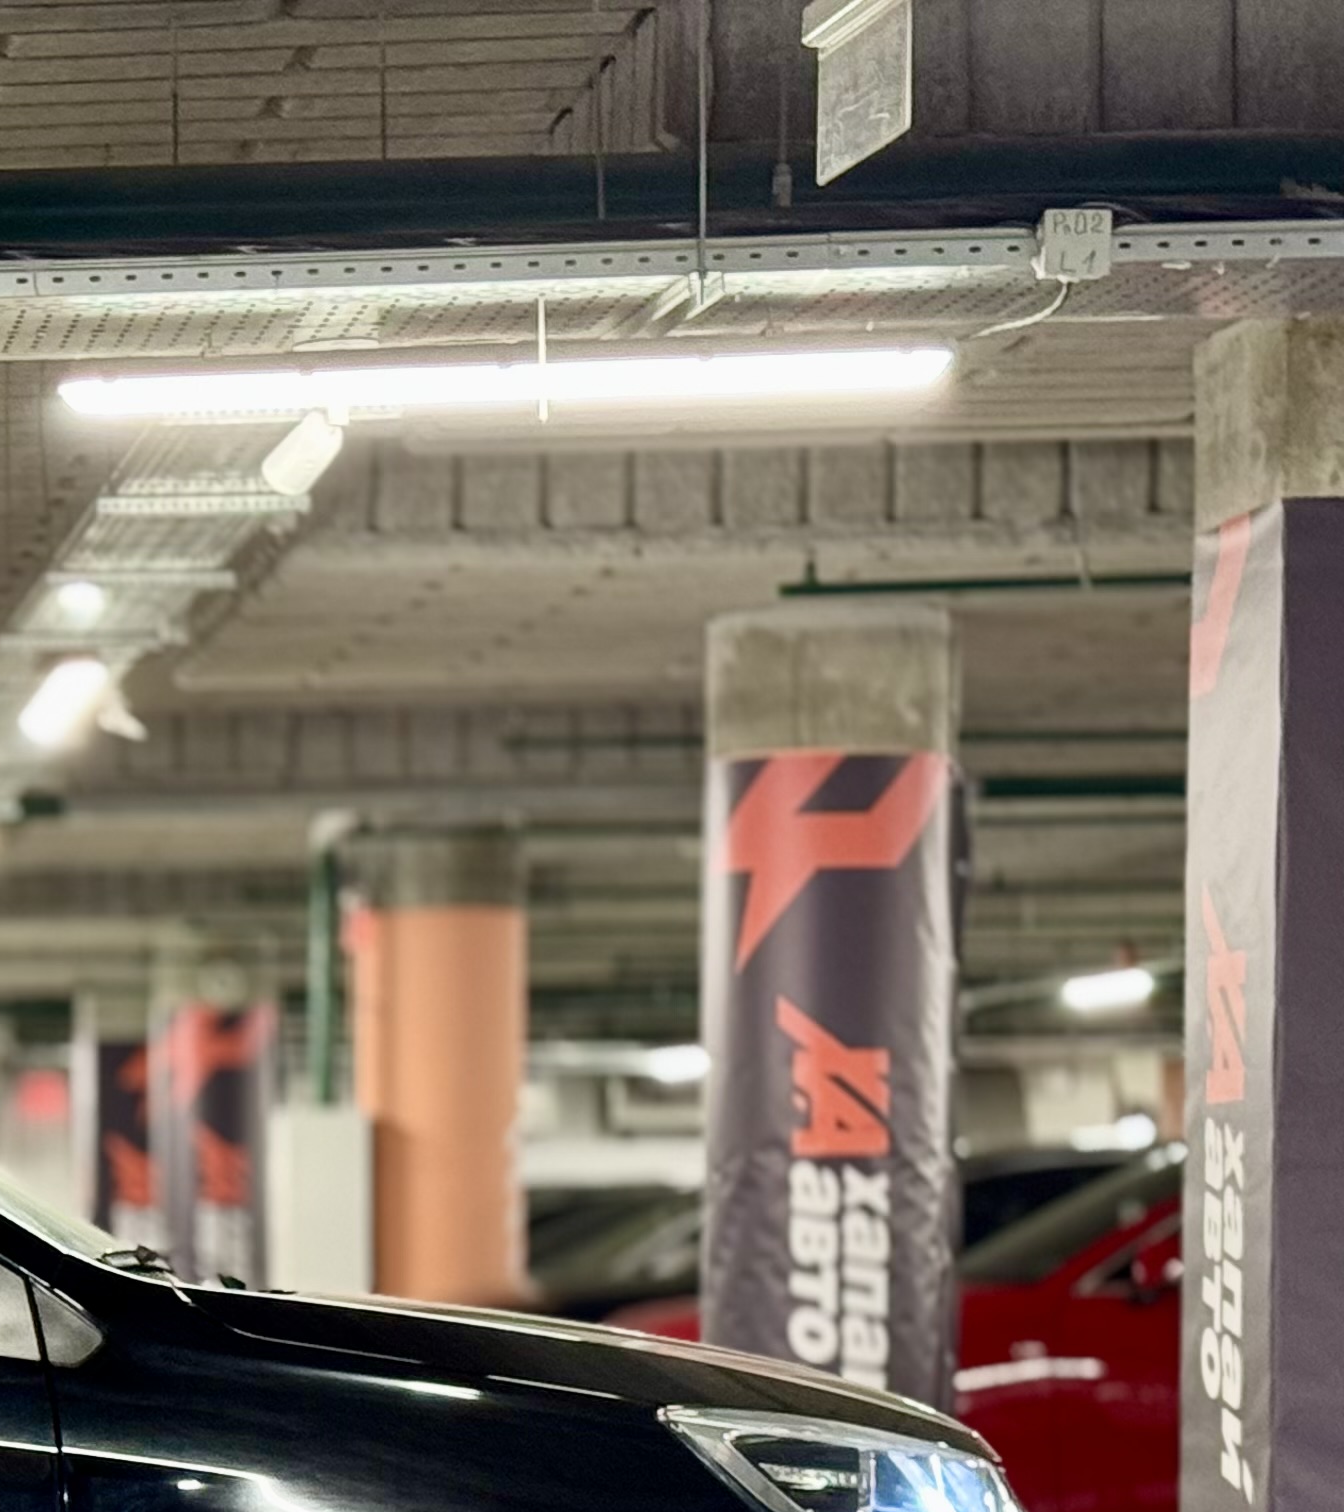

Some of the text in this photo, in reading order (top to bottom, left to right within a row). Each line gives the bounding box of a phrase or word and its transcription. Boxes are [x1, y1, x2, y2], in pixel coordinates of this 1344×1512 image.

[786, 1158, 840, 1366] авто
[1200, 1116, 1224, 1400] авто
[1223, 1122, 1253, 1505] хапай
